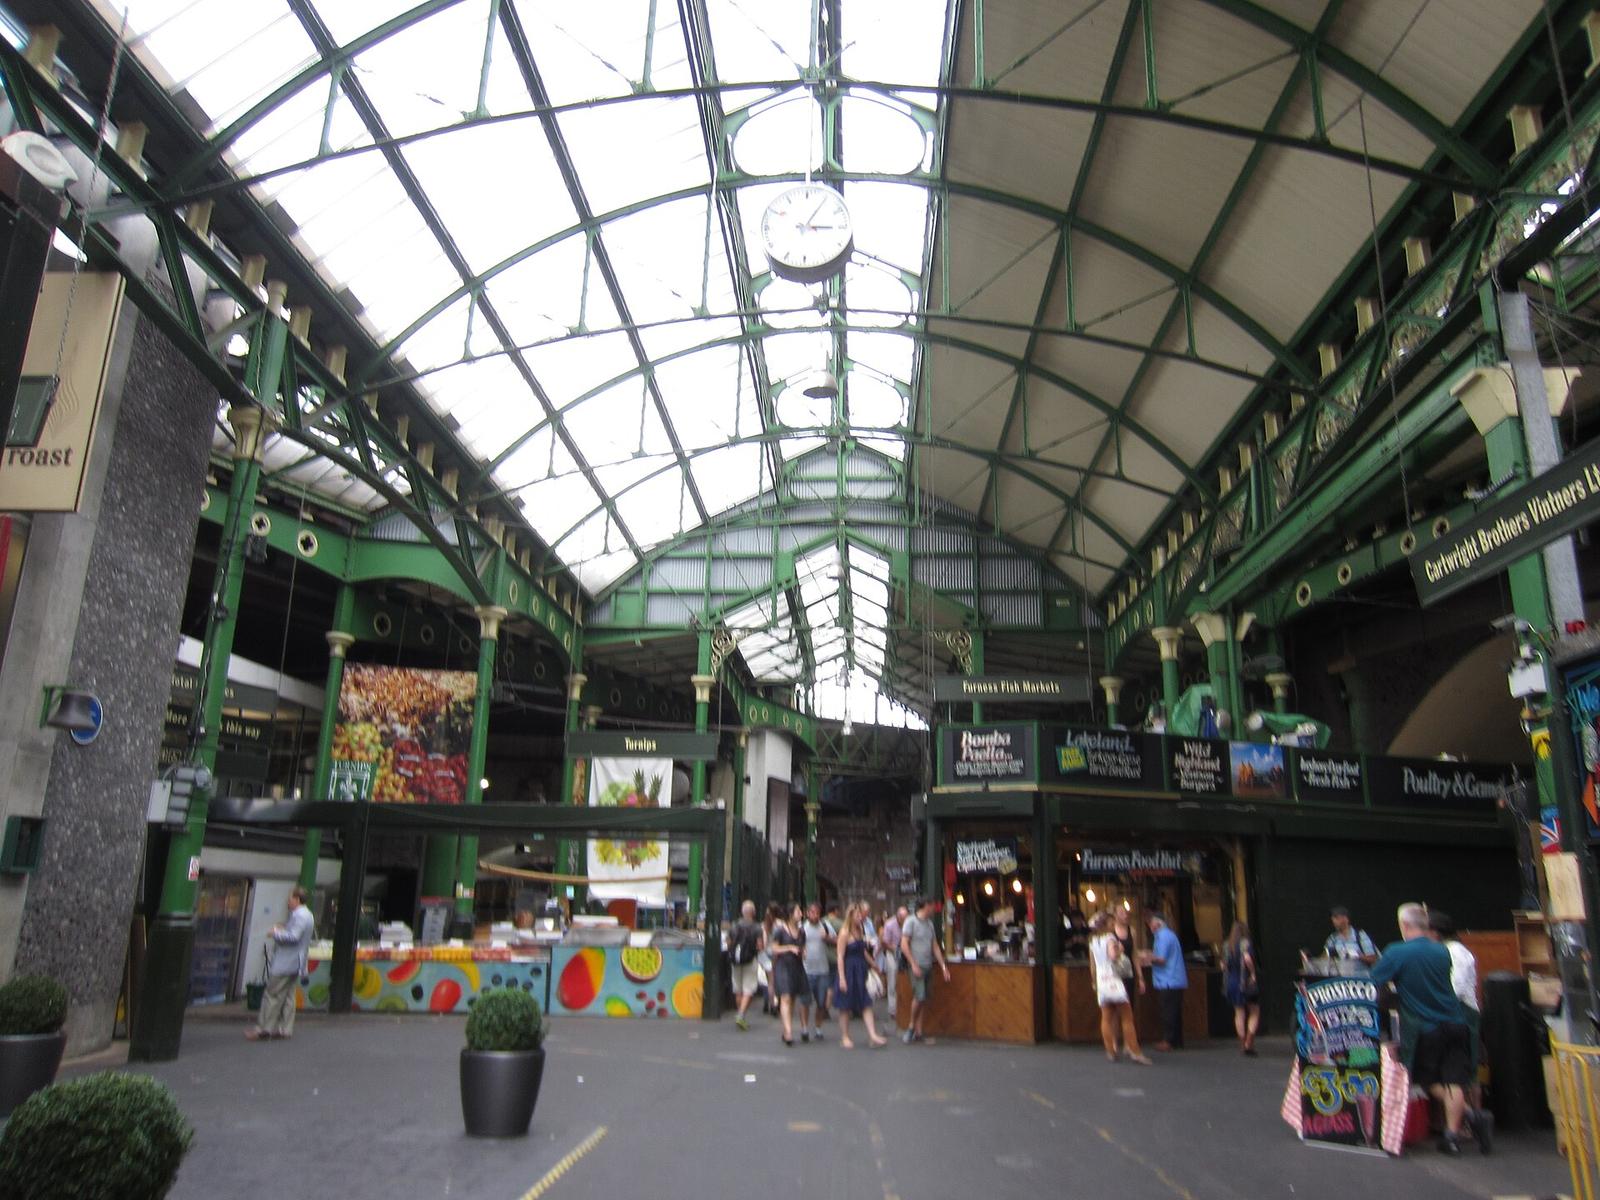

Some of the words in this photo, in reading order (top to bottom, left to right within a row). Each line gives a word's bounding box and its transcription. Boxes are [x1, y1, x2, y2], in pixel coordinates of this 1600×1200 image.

[8, 447, 73, 466] roast
[1424, 535, 1481, 583] Cartwright
[1476, 511, 1531, 555] Brothers
[1526, 479, 1587, 525] Vintners
[963, 679, 999, 694] Furness
[1000, 679, 1020, 694] Fish
[1022, 679, 1060, 694] Markets
[226, 720, 243, 736] this
[244, 726, 261, 741] way
[624, 736, 657, 753] Turnips
[1402, 766, 1451, 799] Poultry
[1082, 848, 1131, 870] Furness
[1308, 980, 1377, 1009] PROSECCO
